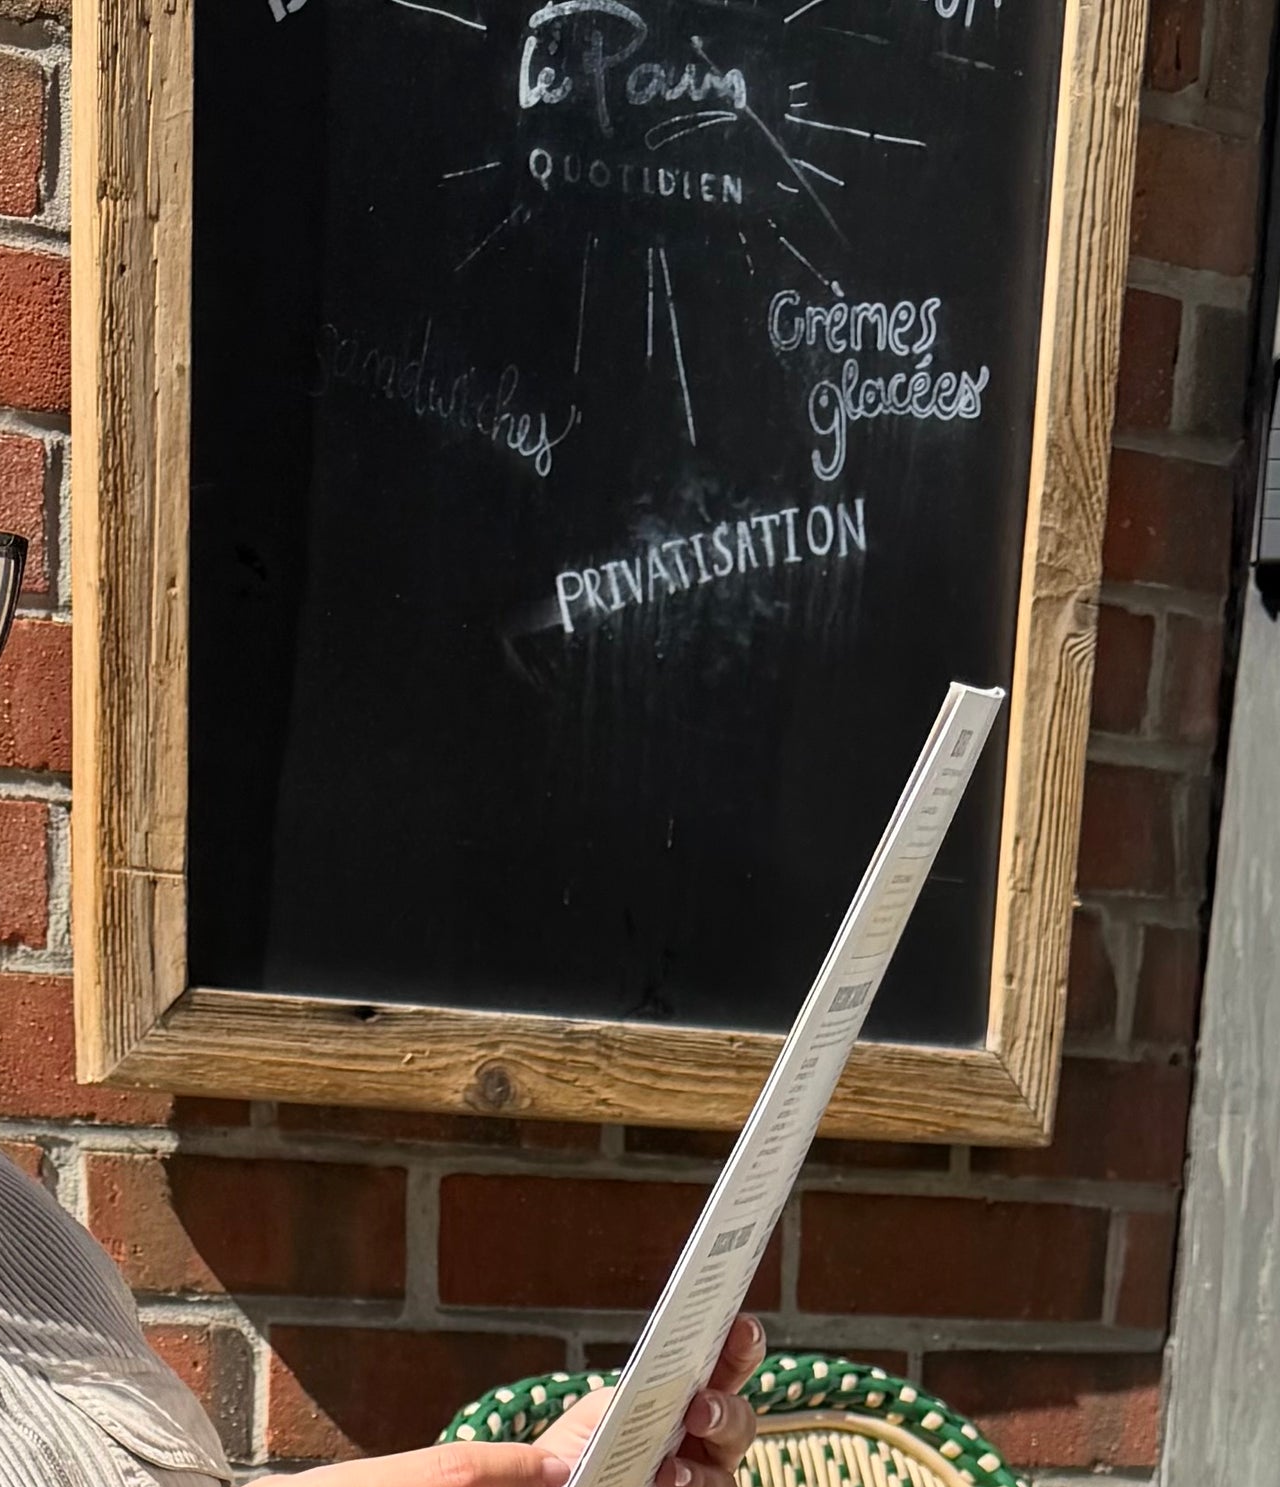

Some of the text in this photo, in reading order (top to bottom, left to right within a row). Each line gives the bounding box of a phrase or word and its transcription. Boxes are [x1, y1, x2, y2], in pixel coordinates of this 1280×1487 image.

[528, 0, 746, 138] Pain
[529, 147, 743, 204] QUOTIDIEN
[769, 281, 941, 356] Crèmes
[808, 353, 990, 481] glacées
[556, 498, 867, 633] PRIVATISATION
